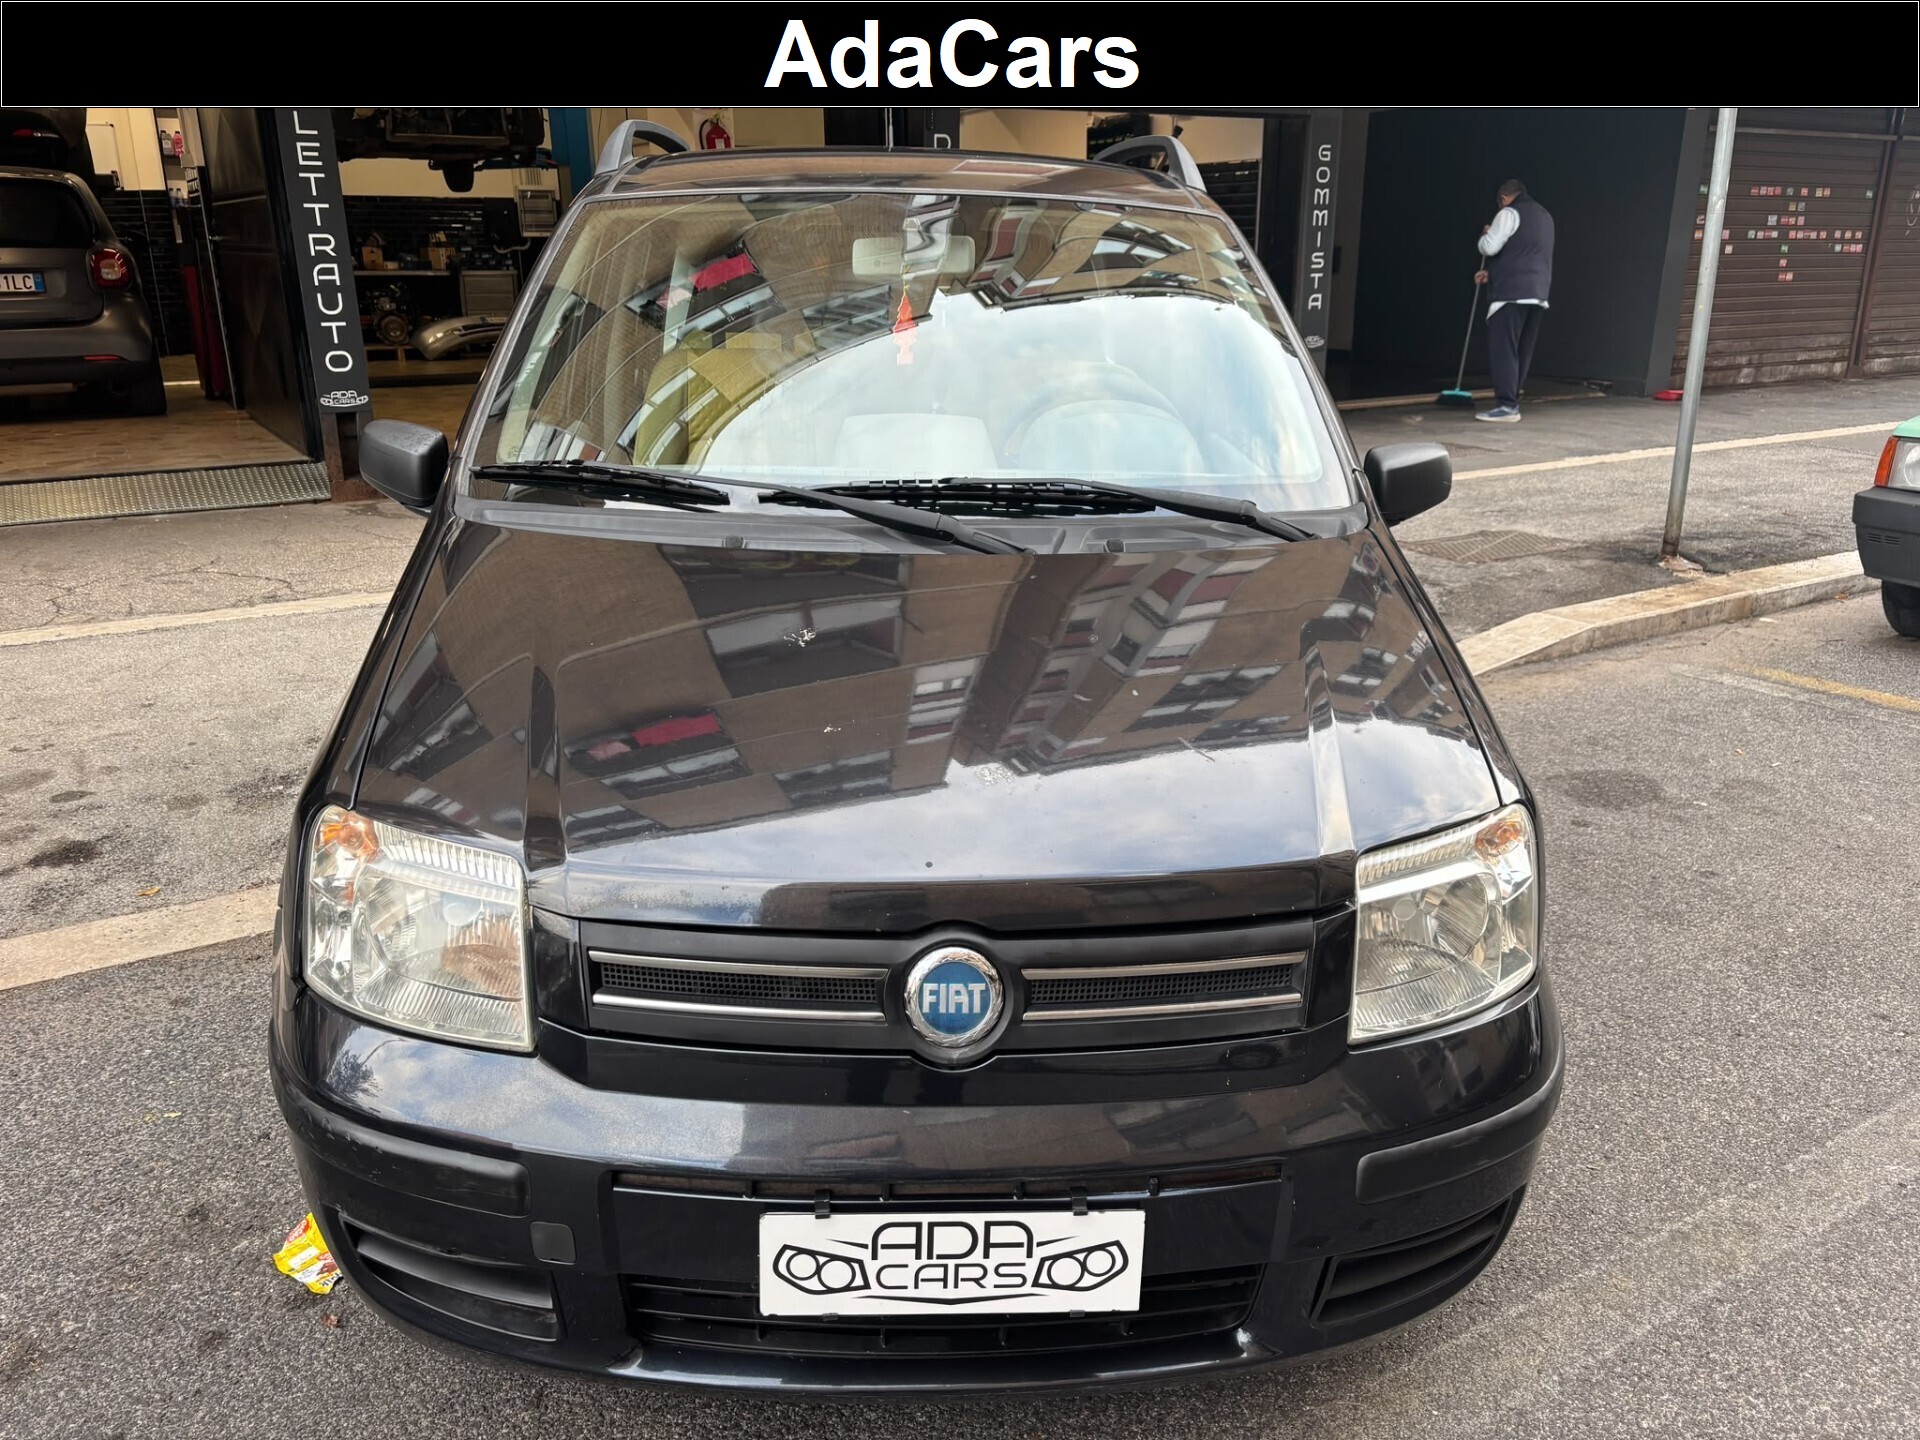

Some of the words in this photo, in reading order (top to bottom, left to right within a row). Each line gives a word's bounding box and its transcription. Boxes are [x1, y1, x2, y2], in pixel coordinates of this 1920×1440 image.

[293, 110, 353, 372] LETTRAUTO
[1308, 145, 1332, 310] GOMMISTA
[0, 275, 32, 290] 1LC
[330, 390, 357, 399] ADA
[922, 983, 986, 1013] FIAT
[871, 1220, 1033, 1260] ADA
[876, 1262, 1028, 1289] CARS
